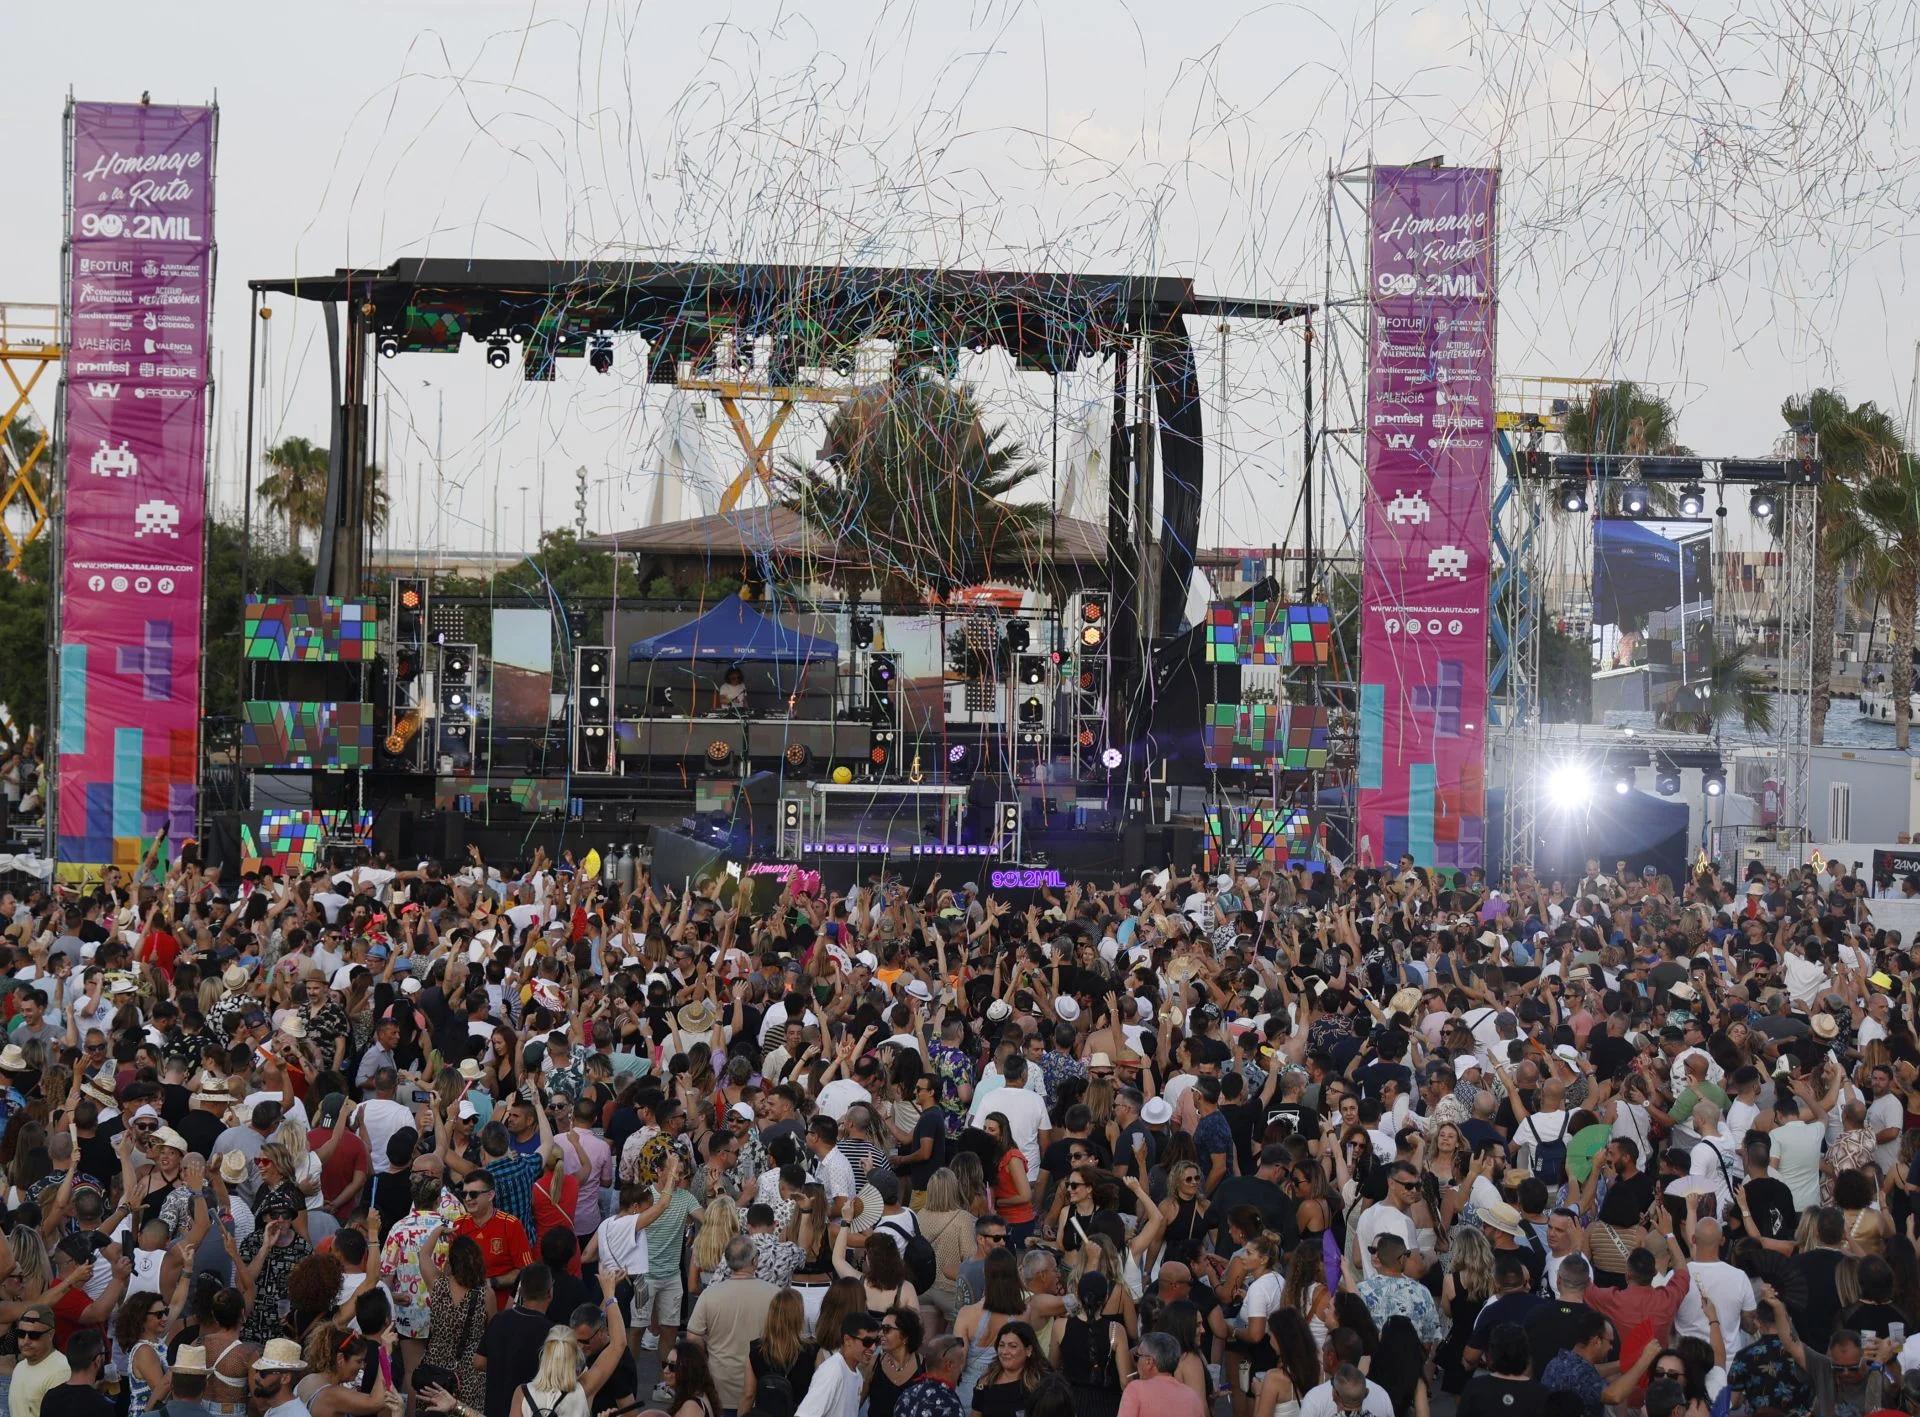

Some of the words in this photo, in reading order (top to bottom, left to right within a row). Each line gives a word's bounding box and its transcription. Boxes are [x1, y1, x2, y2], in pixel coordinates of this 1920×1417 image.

[83, 151, 203, 182] Homenaje
[98, 191, 109, 201] a
[111, 187, 126, 200] la
[129, 178, 194, 208] Ruta
[1379, 212, 1489, 243] Homenaje
[1393, 251, 1402, 261] a
[1423, 237, 1478, 267] Ruta
[90, 261, 129, 272] FOTUR
[86, 295, 133, 303] VALENCIANA
[157, 322, 195, 330] MODERADO
[1386, 318, 1422, 328] FOTUR
[1446, 341, 1470, 350] ACTITUD
[1383, 350, 1426, 358] VALENCIANA
[156, 367, 197, 378] FEDIPE
[73, 562, 193, 572] WWW.HOMENAJEALARUTA.COM
[1370, 606, 1480, 614] WWW.HOMENAJEALARUTA.COM
